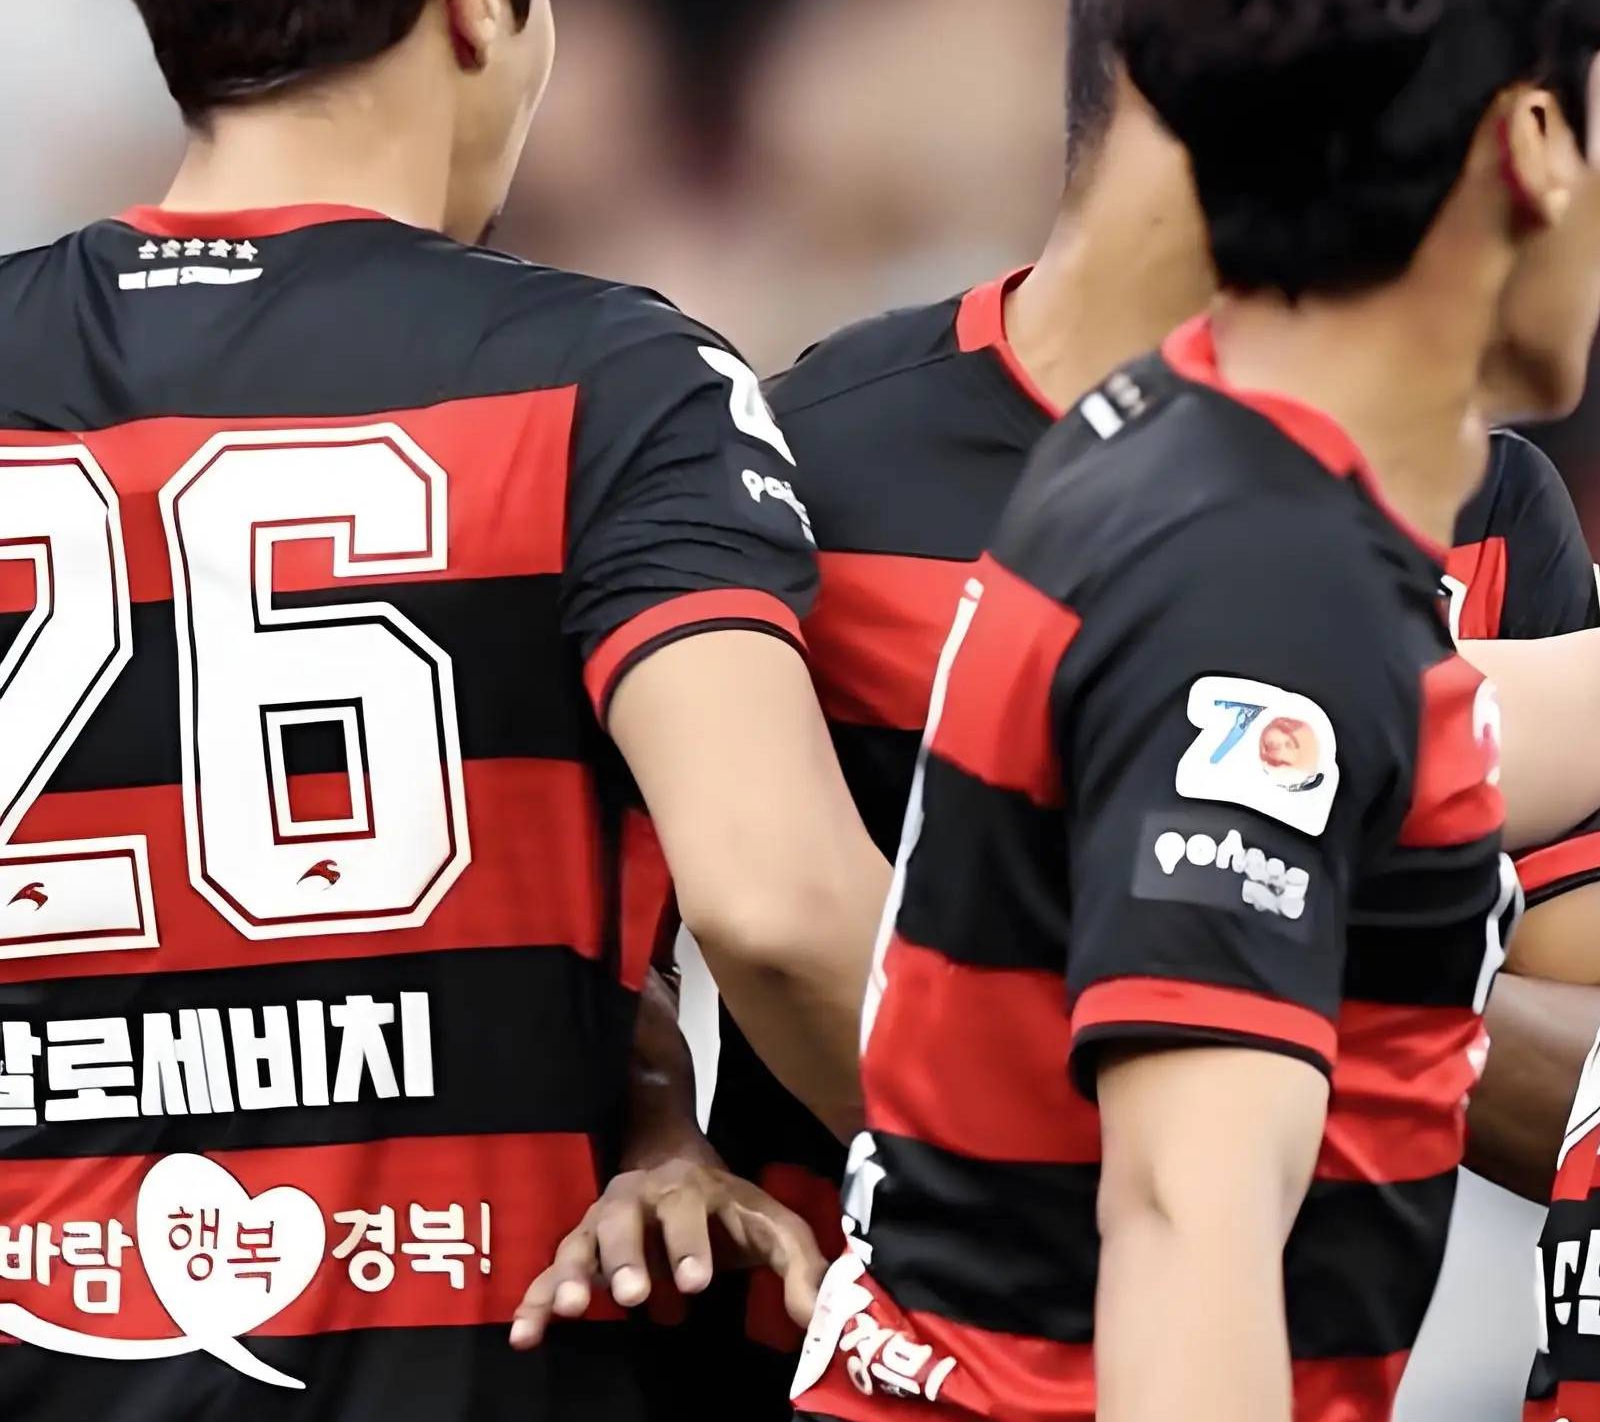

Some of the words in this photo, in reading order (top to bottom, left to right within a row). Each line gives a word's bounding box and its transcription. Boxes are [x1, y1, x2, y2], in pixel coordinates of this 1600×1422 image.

[0, 422, 472, 960] 26
[167, 1205, 281, 1293] 행복
[332, 1201, 491, 1292] 경북!
